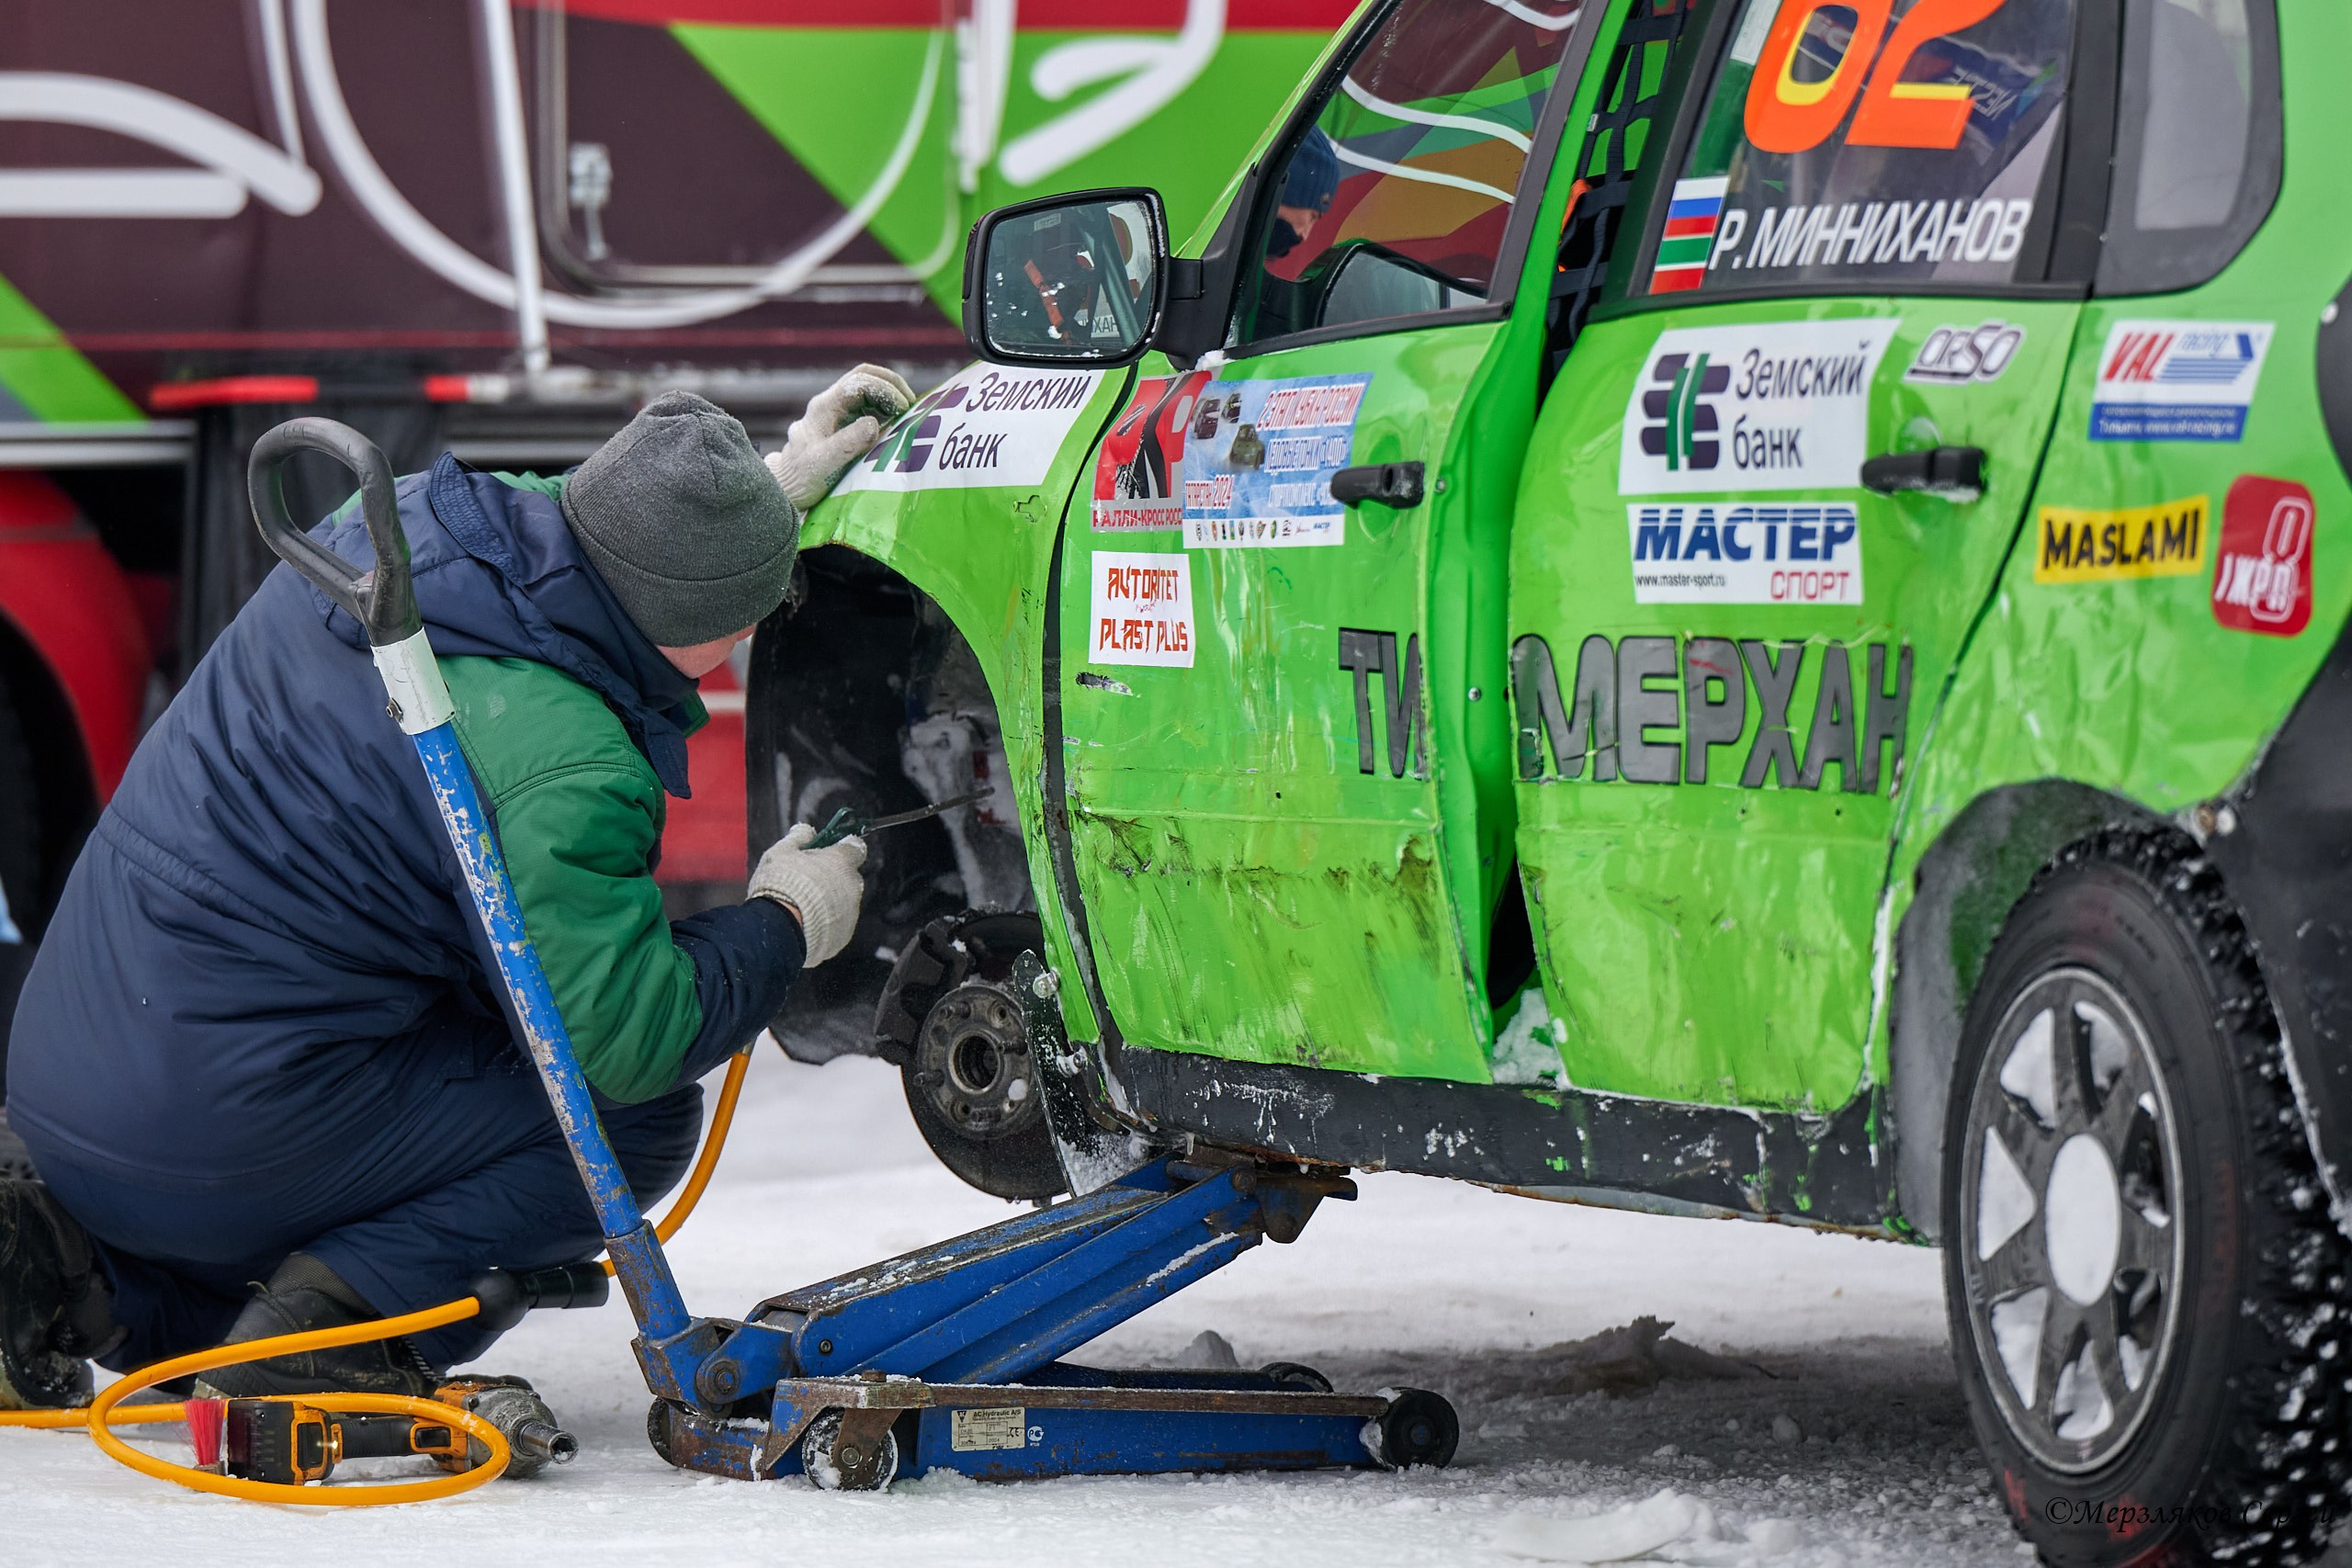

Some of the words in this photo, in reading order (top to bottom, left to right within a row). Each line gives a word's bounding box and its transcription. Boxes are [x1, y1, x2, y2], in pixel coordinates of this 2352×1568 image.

[1747, 197, 2032, 268] МИННИХАНОВ
[1736, 340, 1871, 400] Земский
[2102, 333, 2175, 382] VAL
[939, 423, 1008, 470] банк
[1733, 415, 1803, 470] банк
[1092, 509, 1165, 527] РАЛЛИ-КРОСС
[1633, 508, 1856, 562] МАСТЕР
[2042, 508, 2199, 570] MASLAMI
[1770, 570, 1850, 601] СПОРТ
[1100, 618, 1154, 653] PLAST
[1156, 618, 1189, 654] PLUS
